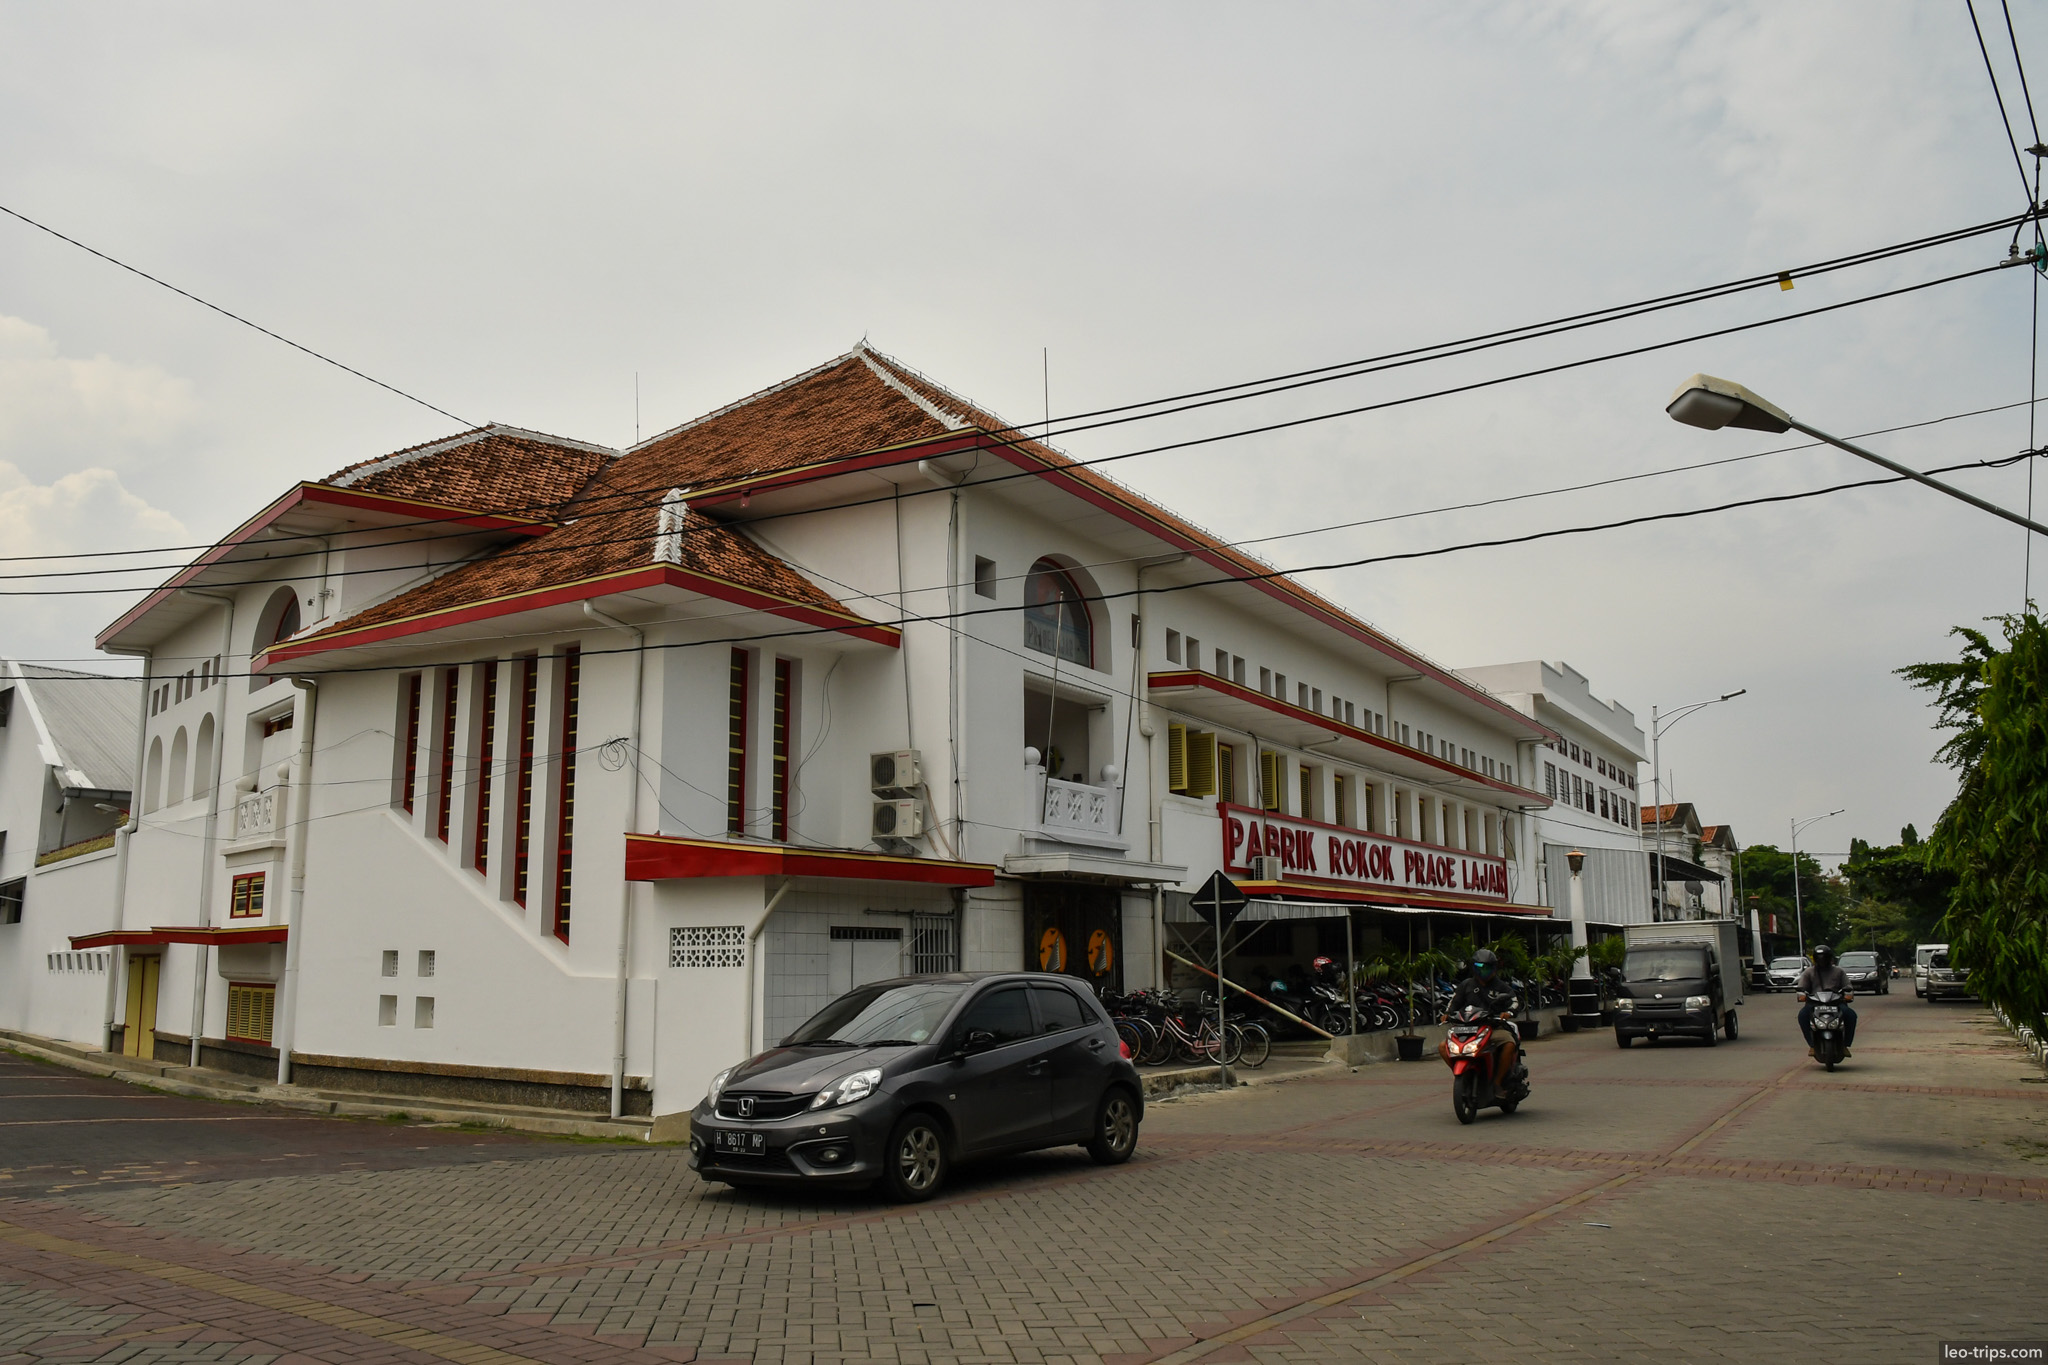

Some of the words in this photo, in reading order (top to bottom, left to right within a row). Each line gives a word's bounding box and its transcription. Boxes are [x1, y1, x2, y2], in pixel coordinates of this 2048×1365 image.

[1229, 817, 1317, 873] PABRIK
[1328, 835, 1395, 882] ROKOK
[1404, 849, 1457, 888] PRAOE
[1462, 859, 1506, 895] LAJAR
[716, 1131, 722, 1144] H
[727, 1132, 746, 1146] 8617
